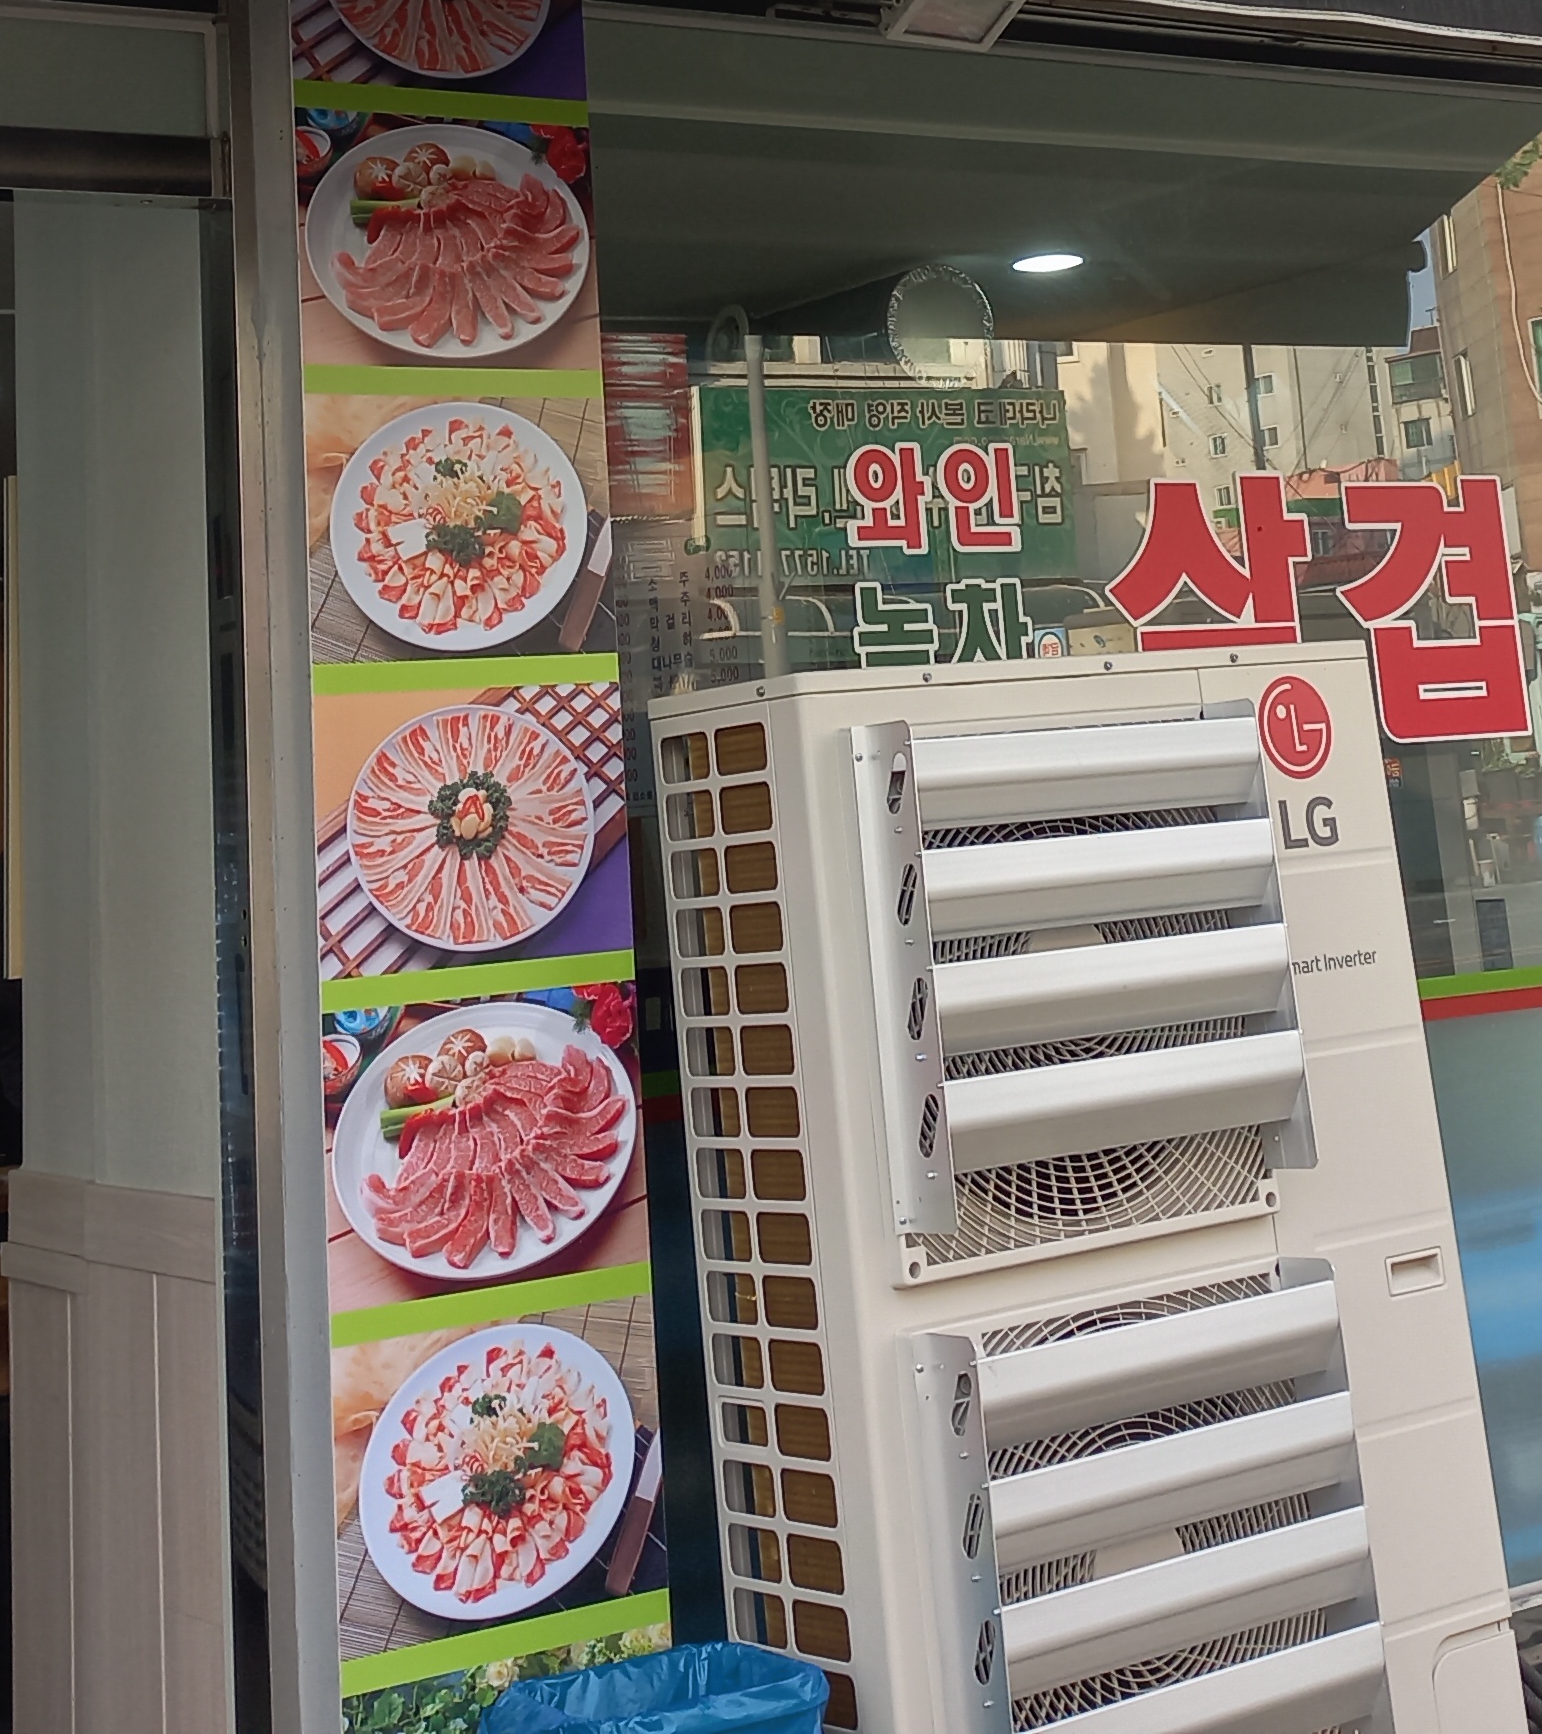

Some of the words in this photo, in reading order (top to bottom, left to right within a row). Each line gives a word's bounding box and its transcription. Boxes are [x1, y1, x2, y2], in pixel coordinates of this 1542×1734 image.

[848, 444, 1020, 552] 와인
[855, 579, 1032, 668] 녹차
[1278, 796, 1341, 850] LG
[1291, 954, 1322, 975] mart
[1324, 950, 1377, 971] Inverter
